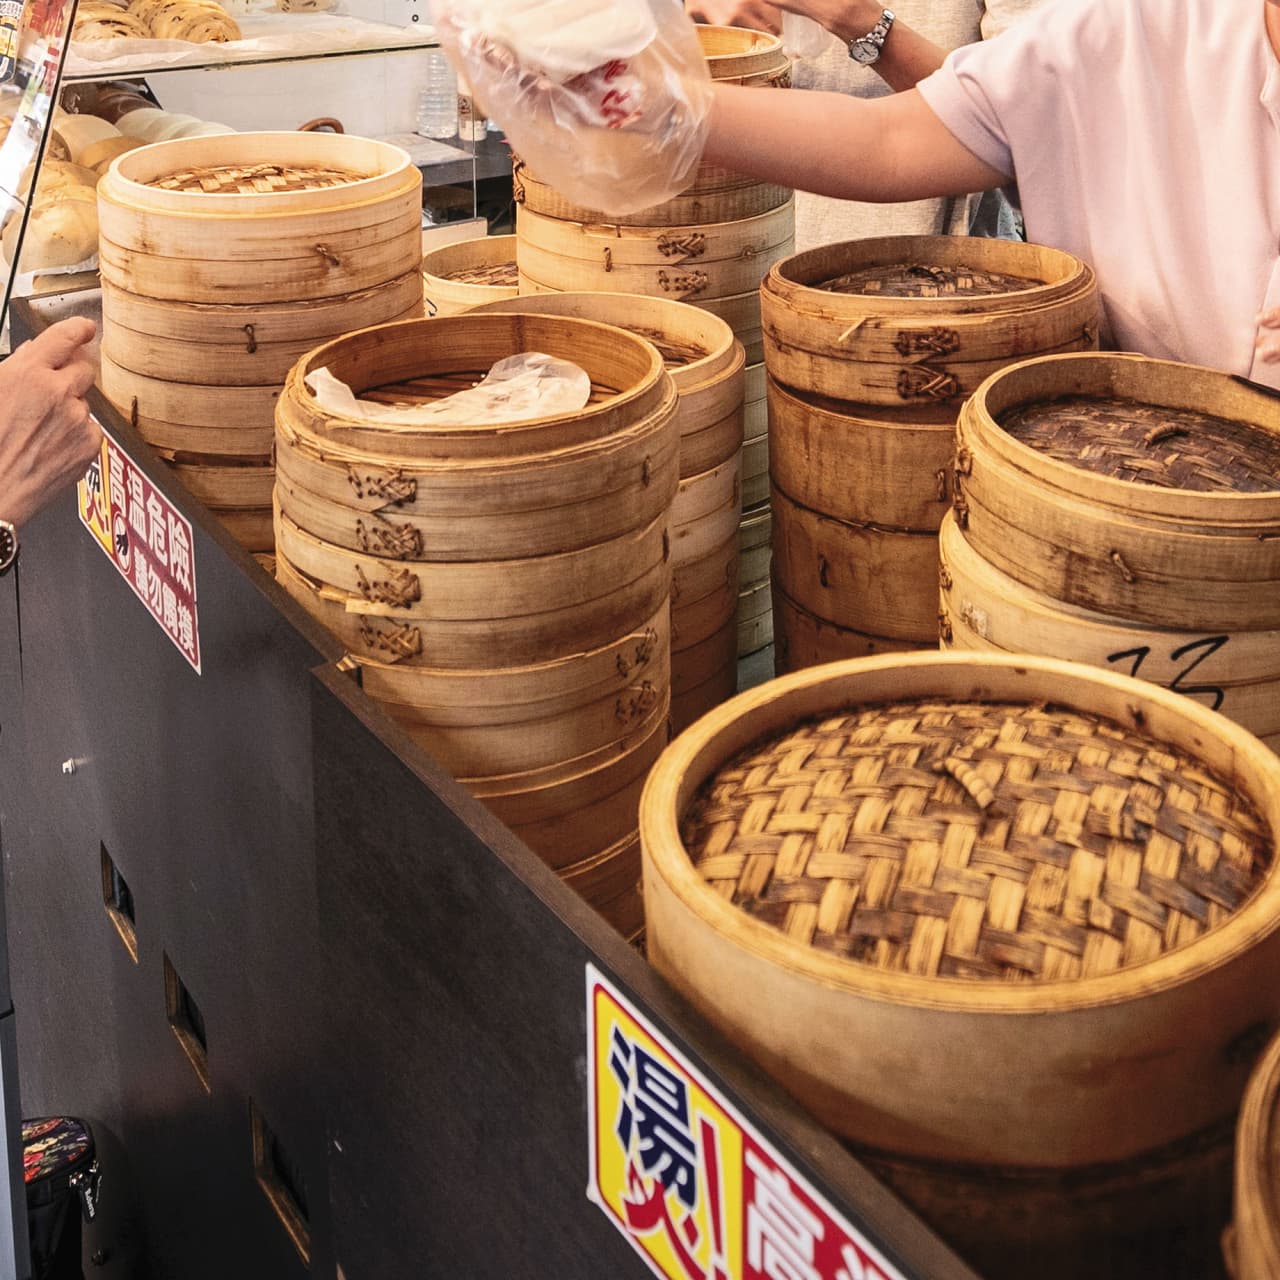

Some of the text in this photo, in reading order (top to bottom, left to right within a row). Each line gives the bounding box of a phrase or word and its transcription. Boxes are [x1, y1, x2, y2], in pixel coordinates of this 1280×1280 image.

[108, 447, 191, 595] 高溫危險
[133, 547, 195, 659] 請勿觸摸
